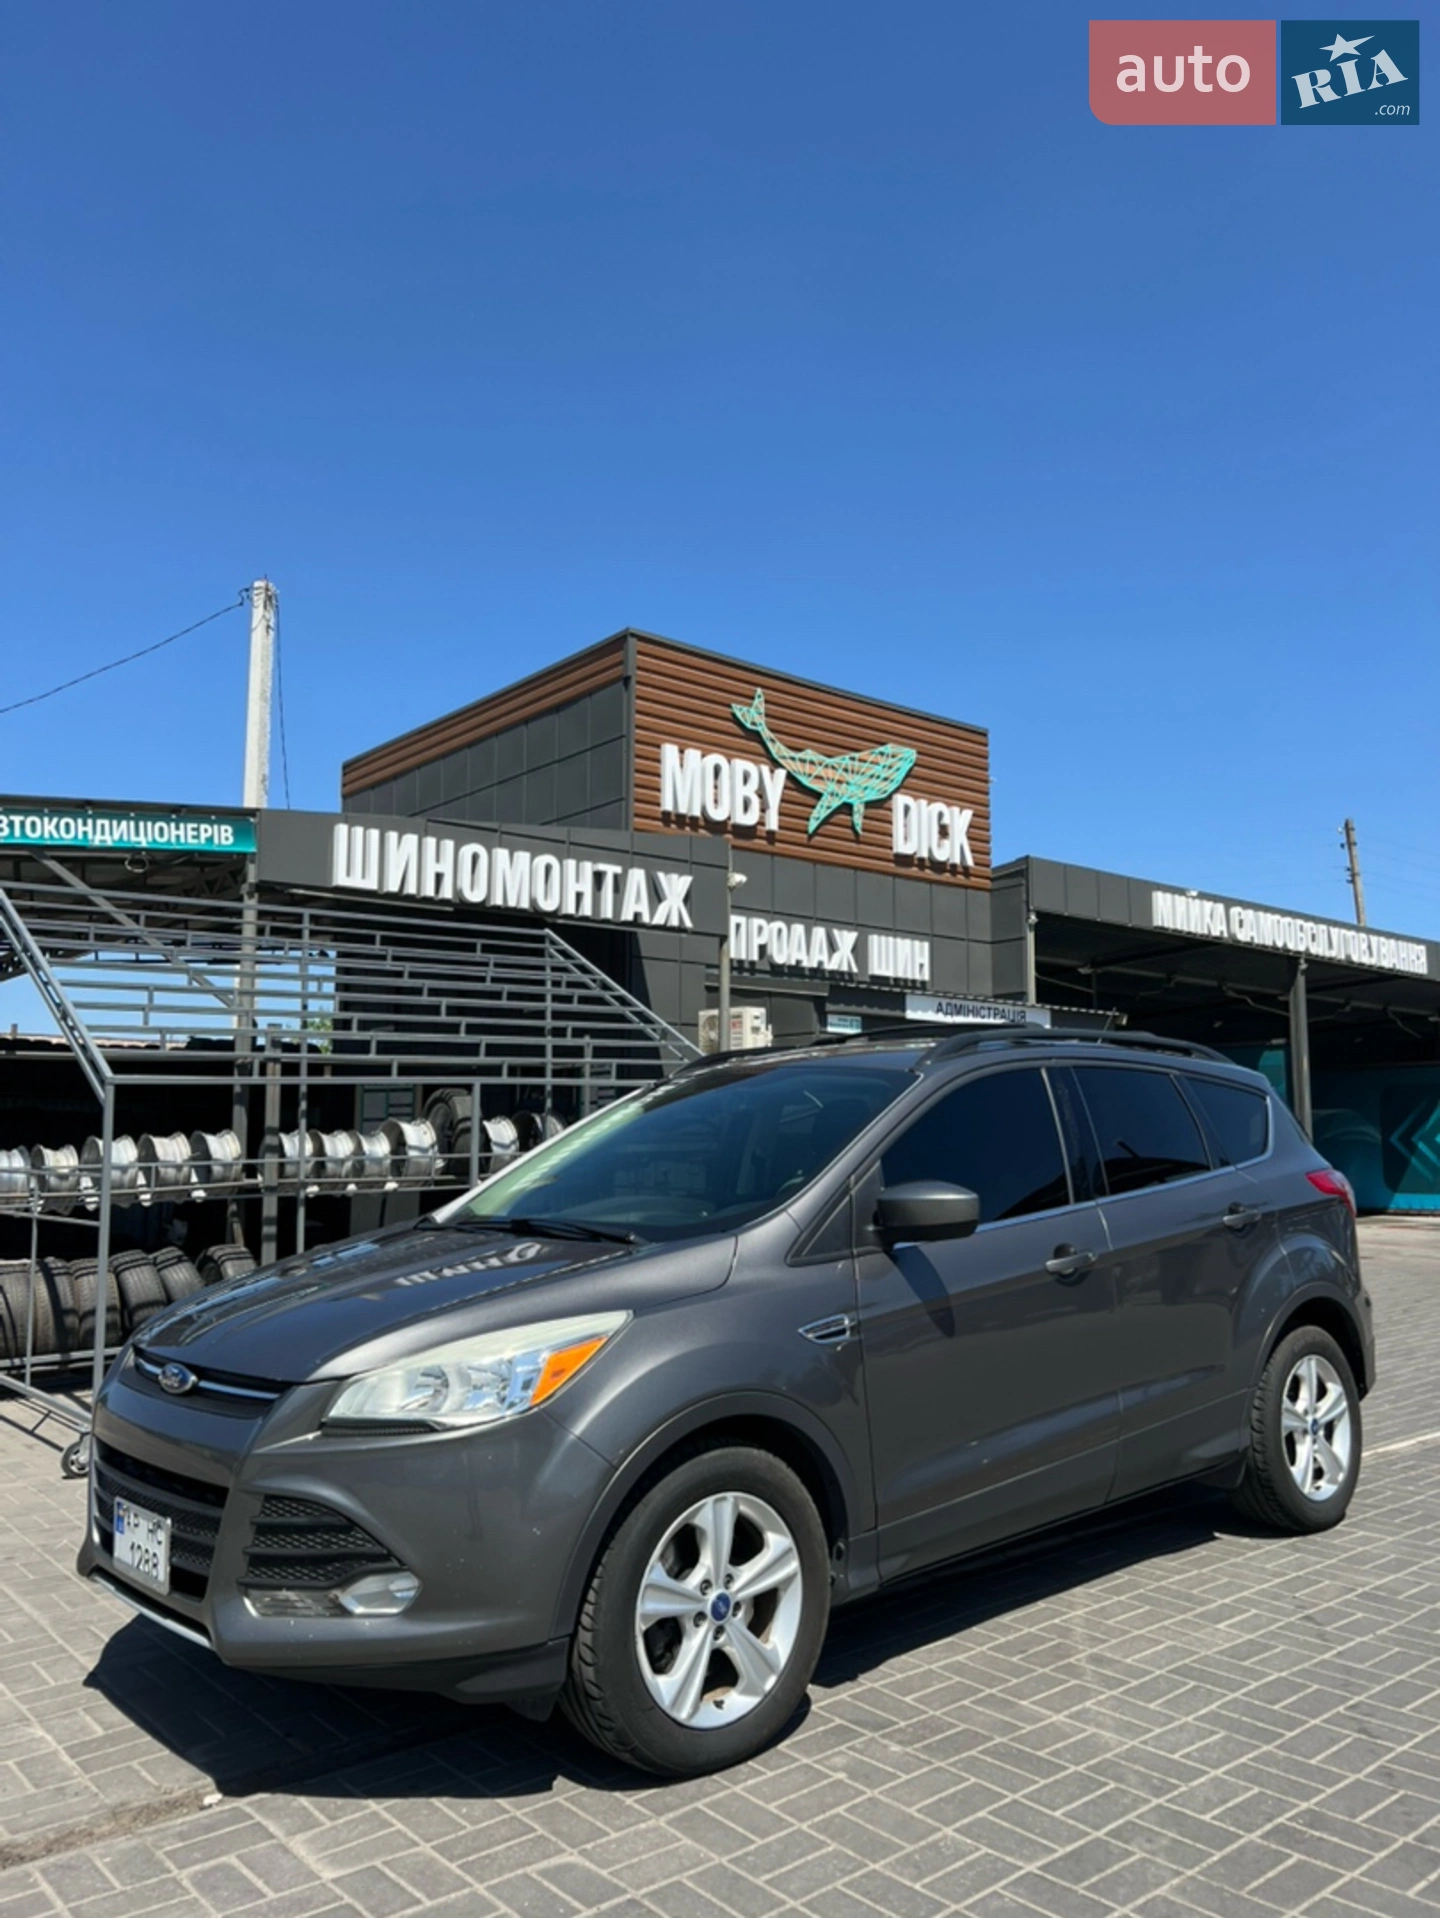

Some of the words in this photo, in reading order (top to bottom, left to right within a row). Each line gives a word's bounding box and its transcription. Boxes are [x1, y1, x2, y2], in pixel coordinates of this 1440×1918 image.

[660, 743, 787, 832] MOBY
[891, 794, 975, 867] DICK
[332, 823, 694, 928] ШИНОМОНТАЖ
[1152, 889, 1228, 938] МИЙКА
[729, 914, 859, 973] ПРОДАЖ
[868, 934, 930, 981] ШИН
[935, 1001, 1026, 1023] АДМІНІСТРАЦІЯ
